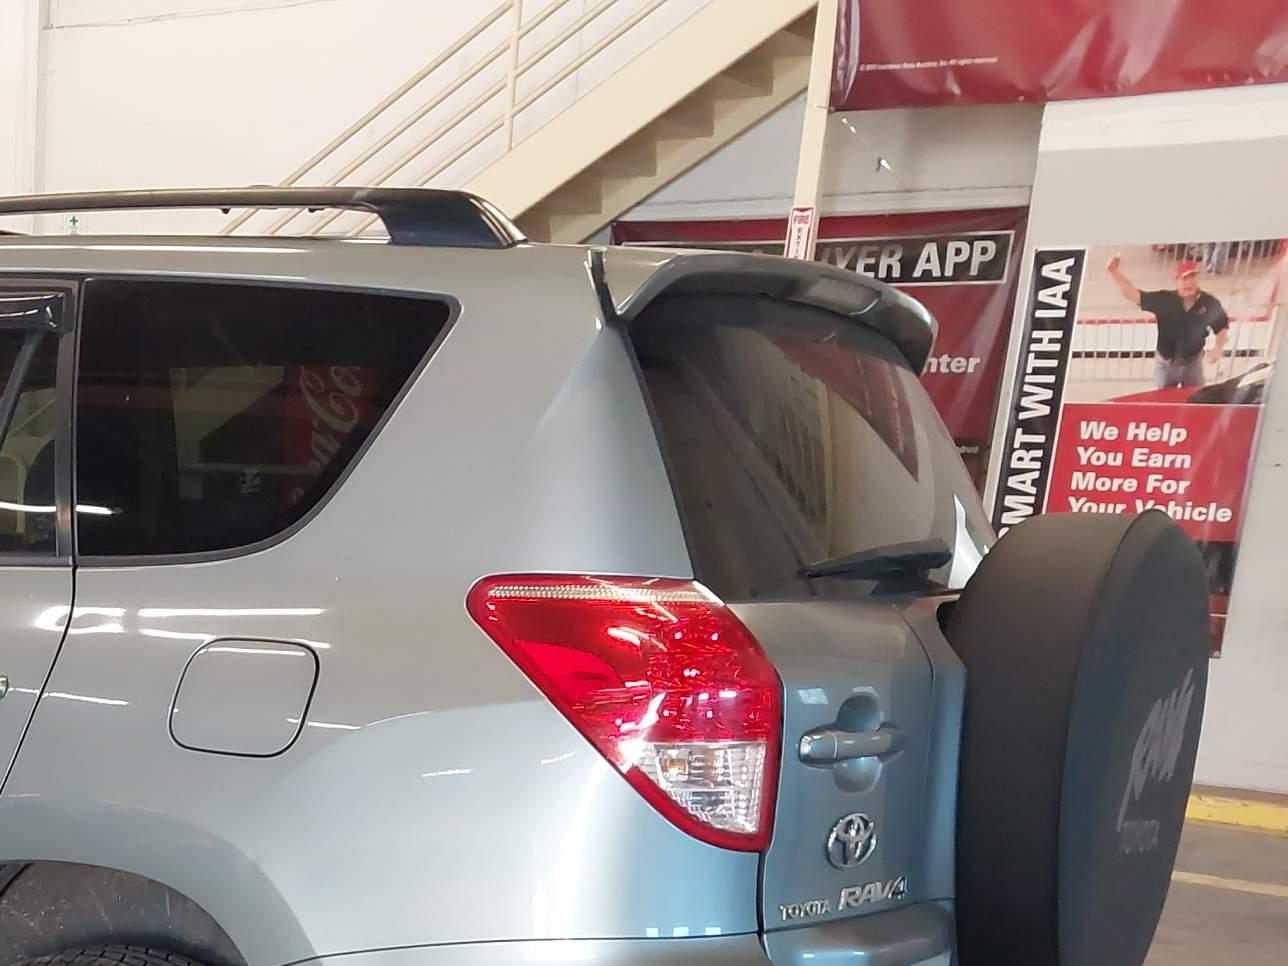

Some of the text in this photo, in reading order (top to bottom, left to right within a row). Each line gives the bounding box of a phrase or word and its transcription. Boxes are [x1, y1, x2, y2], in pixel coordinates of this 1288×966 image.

[912, 239, 997, 278] APP
[998, 257, 1076, 539] MART WITH IAA
[1079, 420, 1188, 446] We Help
[1077, 446, 1192, 468] You Earn
[1070, 471, 1191, 494] More For
[779, 876, 908, 921] TOYOTA RAV4
